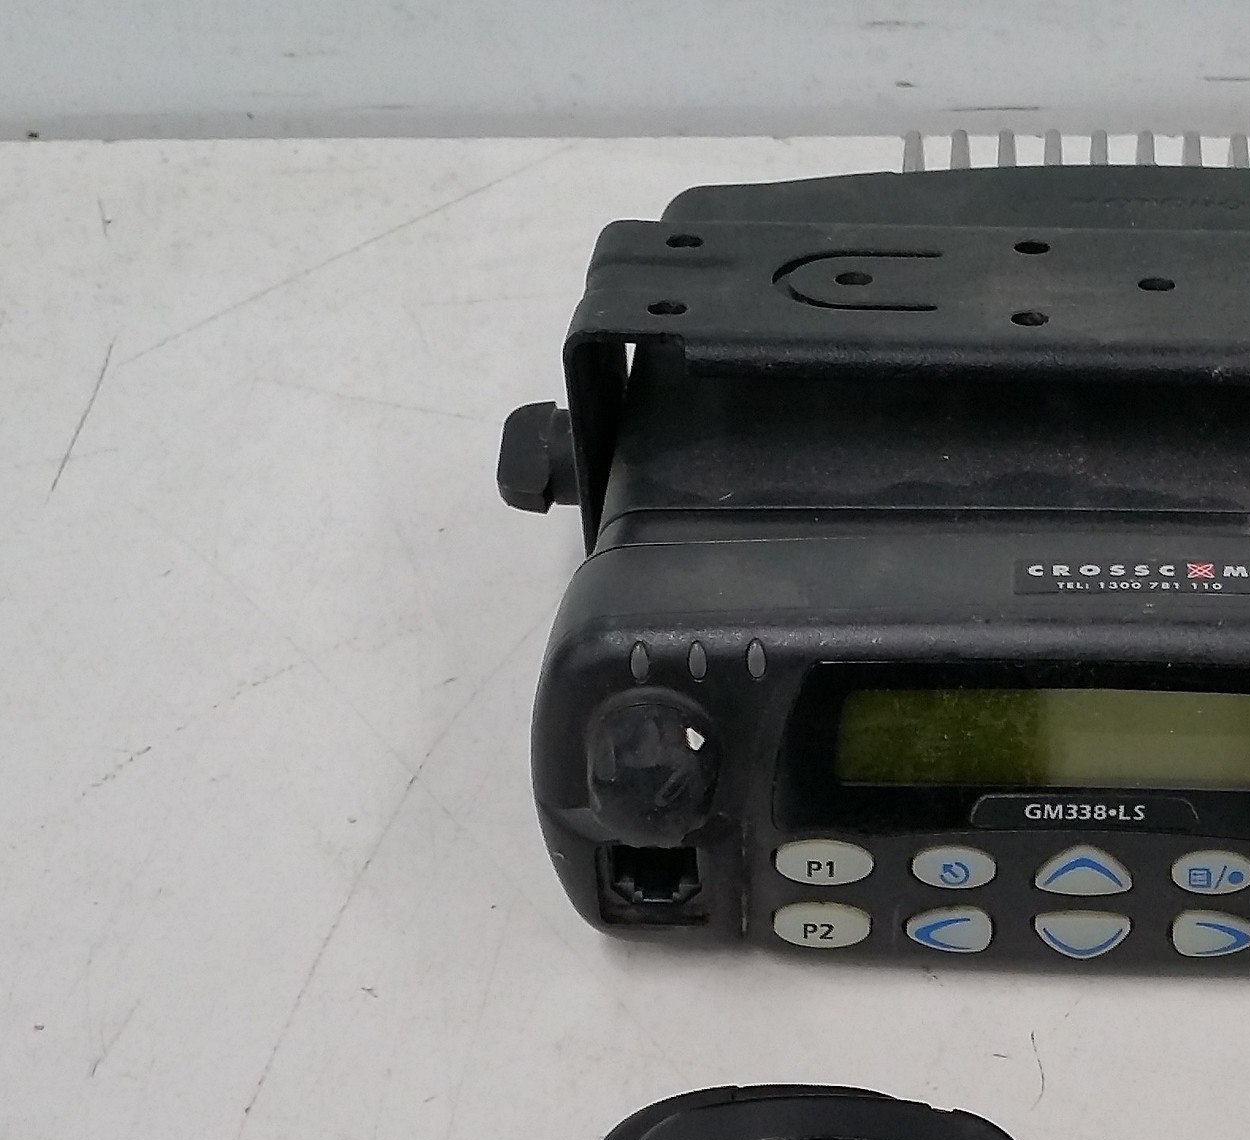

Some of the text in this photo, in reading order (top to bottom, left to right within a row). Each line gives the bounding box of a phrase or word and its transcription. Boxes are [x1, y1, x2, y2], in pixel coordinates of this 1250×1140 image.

[1099, 580, 1142, 590] 1300
[1149, 581, 1180, 590] 781
[1191, 582, 1223, 590] 110
[805, 859, 837, 878] P1
[801, 923, 835, 941] P2
